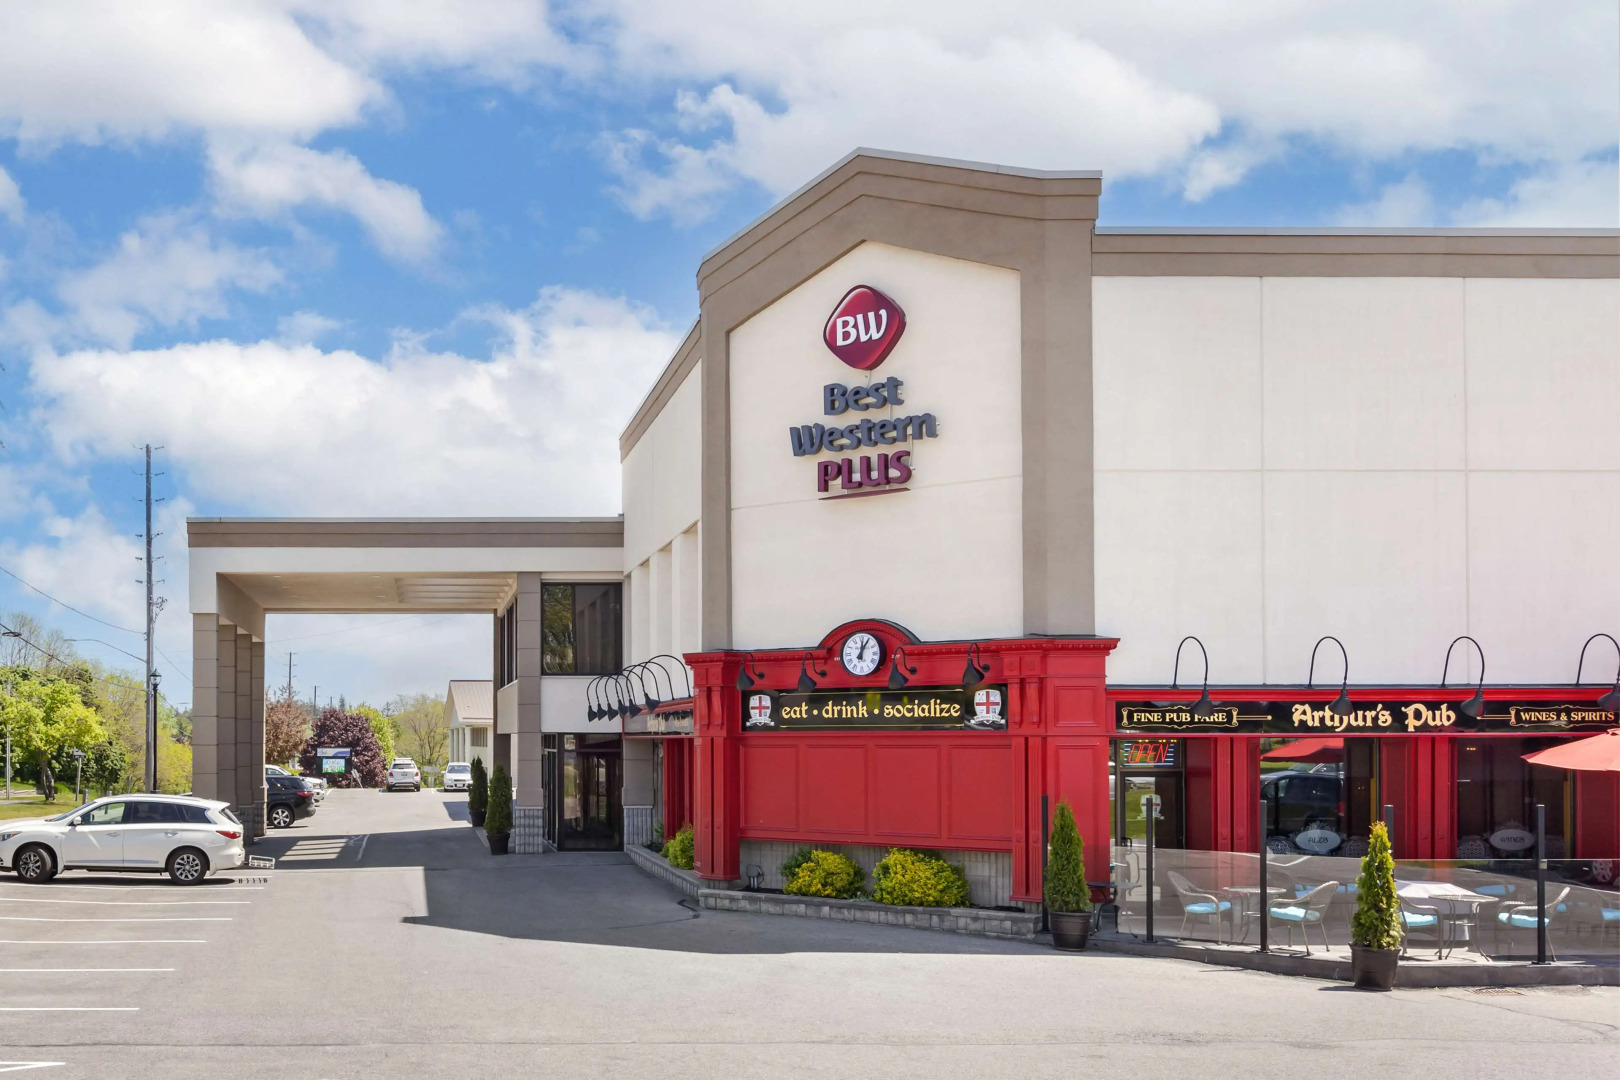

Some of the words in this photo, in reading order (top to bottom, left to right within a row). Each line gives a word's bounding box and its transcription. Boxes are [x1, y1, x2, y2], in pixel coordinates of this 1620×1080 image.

[836, 309, 888, 347] BW
[823, 376, 904, 416] Best
[789, 412, 938, 456] Western
[817, 450, 913, 493] PLUS
[781, 701, 808, 719] eat
[822, 699, 869, 719] drink
[883, 698, 961, 718] socialize
[1133, 712, 1162, 722] FINE
[1165, 712, 1191, 722] PUB
[1401, 702, 1456, 732] Pub
[1520, 711, 1557, 721] WINES
[1559, 712, 1568, 721] &
[1570, 711, 1615, 721] SPIRITS
[1128, 743, 1169, 763] OPEN
